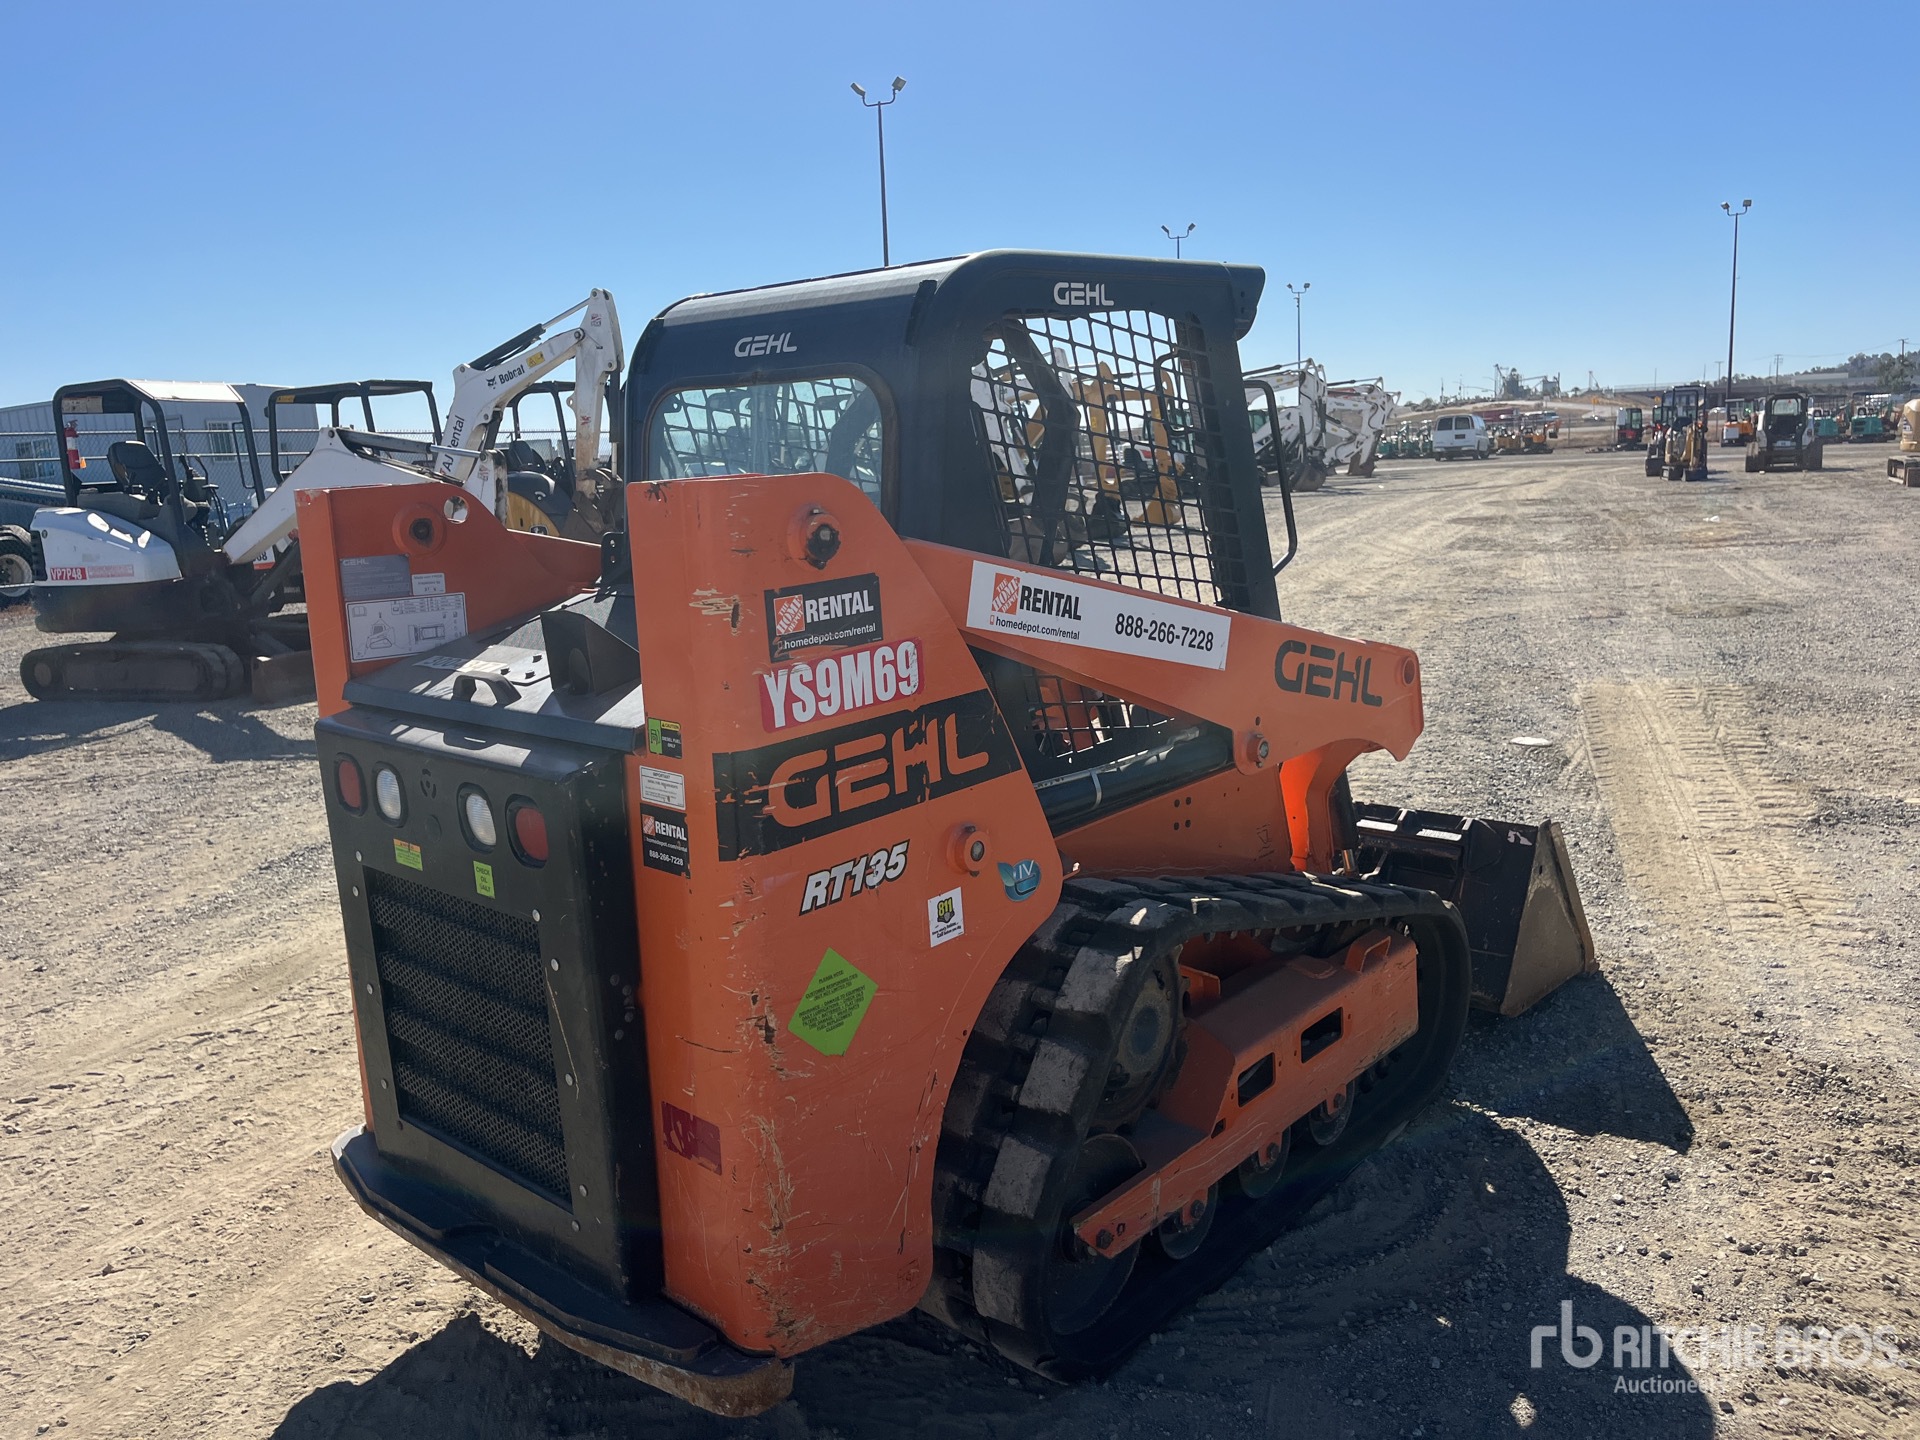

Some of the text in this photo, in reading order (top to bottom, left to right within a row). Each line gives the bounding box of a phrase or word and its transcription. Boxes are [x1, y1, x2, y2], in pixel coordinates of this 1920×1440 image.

[1053, 281, 1115, 306] GEHL
[734, 332, 798, 358] GEHL
[498, 364, 525, 384] Bobcat
[442, 415, 465, 472] AJ ental
[50, 568, 82, 580] VP7P48
[342, 558, 369, 566] GEHL
[805, 590, 874, 623] RENTAL
[992, 576, 1020, 612] HOME
[1020, 585, 1082, 621] RENTAL
[776, 594, 803, 634] HOME
[784, 623, 876, 650] homedepot.com/rental
[995, 616, 1080, 640] homedepot.com/rental
[1115, 613, 1214, 652] 888-266-7228
[764, 641, 919, 728] YS9M69
[1274, 640, 1383, 707] GEHL
[768, 713, 990, 828] GEHL
[655, 820, 687, 841] RENTAL
[475, 867, 491, 877] CHECK
[480, 876, 488, 884] OIL
[799, 840, 910, 914] RT135
[938, 898, 953, 917] 811
